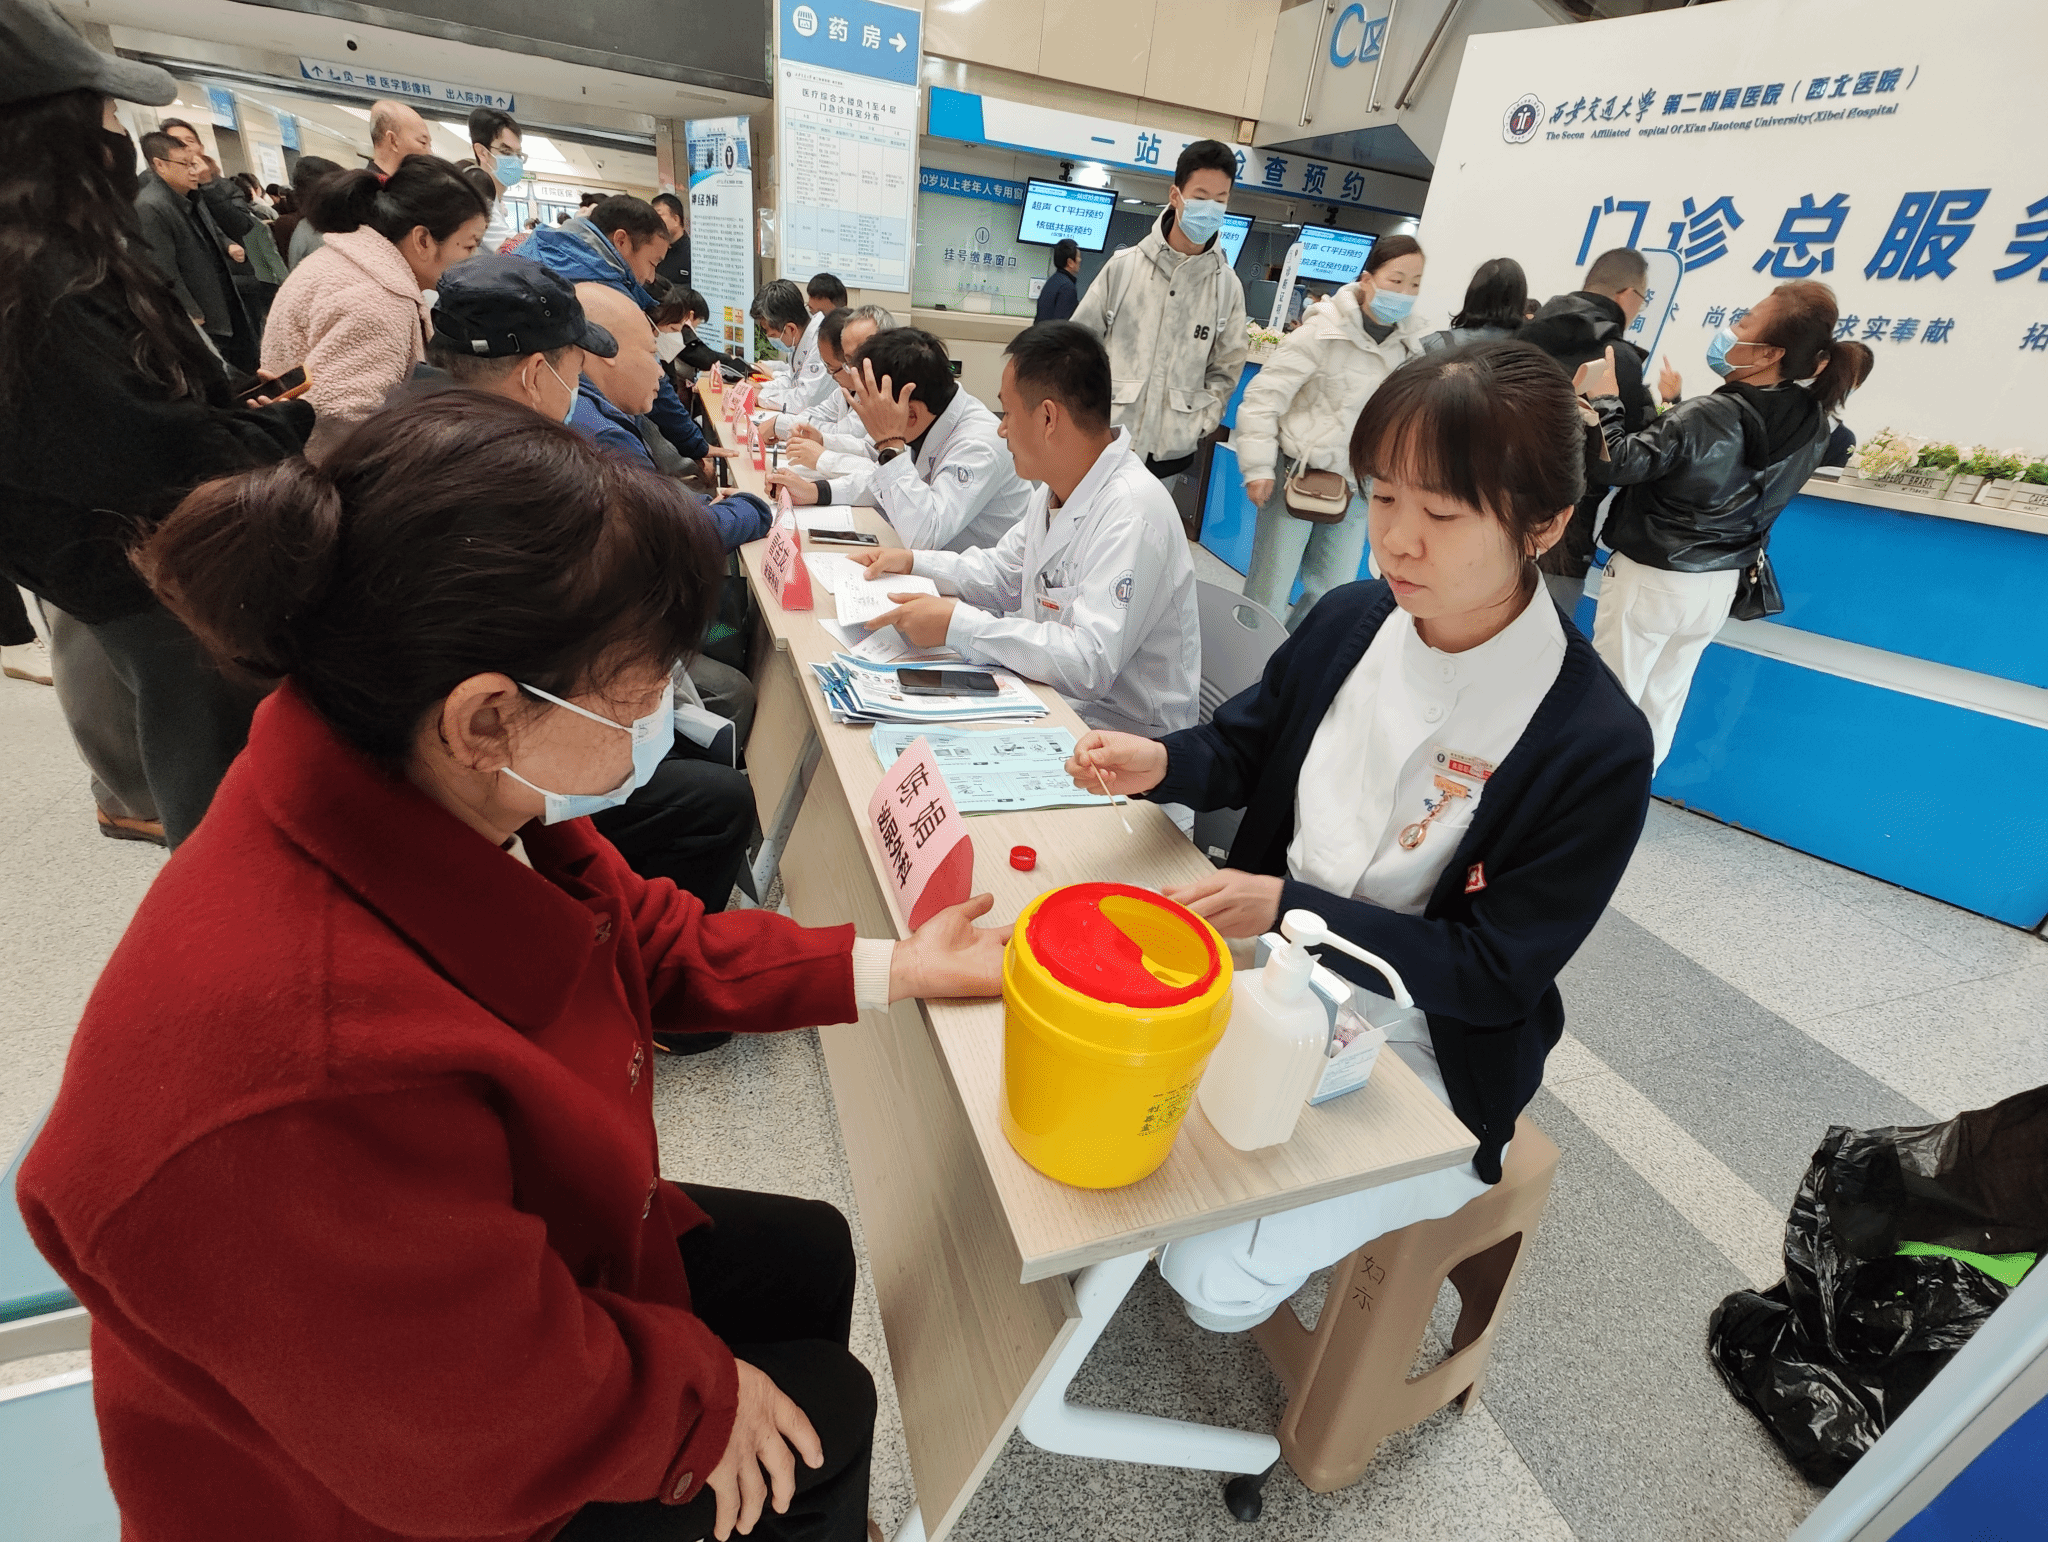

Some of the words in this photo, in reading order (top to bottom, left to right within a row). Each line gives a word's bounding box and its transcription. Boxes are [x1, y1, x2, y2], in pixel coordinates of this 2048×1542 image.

[828, 16, 881, 49] 药房
[1330, 3, 1389, 68] C区
[343, 70, 377, 87] 负一楼
[379, 76, 432, 96] 医学影像科
[445, 88, 493, 106] 出入院办理
[802, 88, 897, 115] 医疗综合大楼负1至4层
[819, 102, 881, 121] 门急诊科室分布
[1549, 88, 1656, 126] 西安交通大学
[1546, 131, 1560, 141] The
[1562, 131, 1585, 140] Secon
[1591, 128, 1632, 139] Affiliated
[1638, 125, 1669, 137] ospital
[1670, 124, 1682, 135] Of
[1682, 122, 1706, 134] Xi'an
[1707, 120, 1753, 132] Jiaotong
[1849, 103, 1899, 120] Hospital
[691, 193, 719, 207] 神经外科
[920, 173, 1024, 201] 0岁以上老年人专用窗
[1031, 200, 1052, 211] 超声
[1054, 203, 1104, 219] CT平扫预约
[1036, 219, 1093, 236] 核磁共振预约
[944, 247, 1018, 268] 挂号缴费窗口
[1299, 258, 1359, 274] 院床位预约登记
[1193, 324, 1210, 341] 86
[1908, 476, 1935, 489] BRASIL
[896, 762, 947, 849] 陈娟
[877, 800, 913, 890] 泌尿外科
